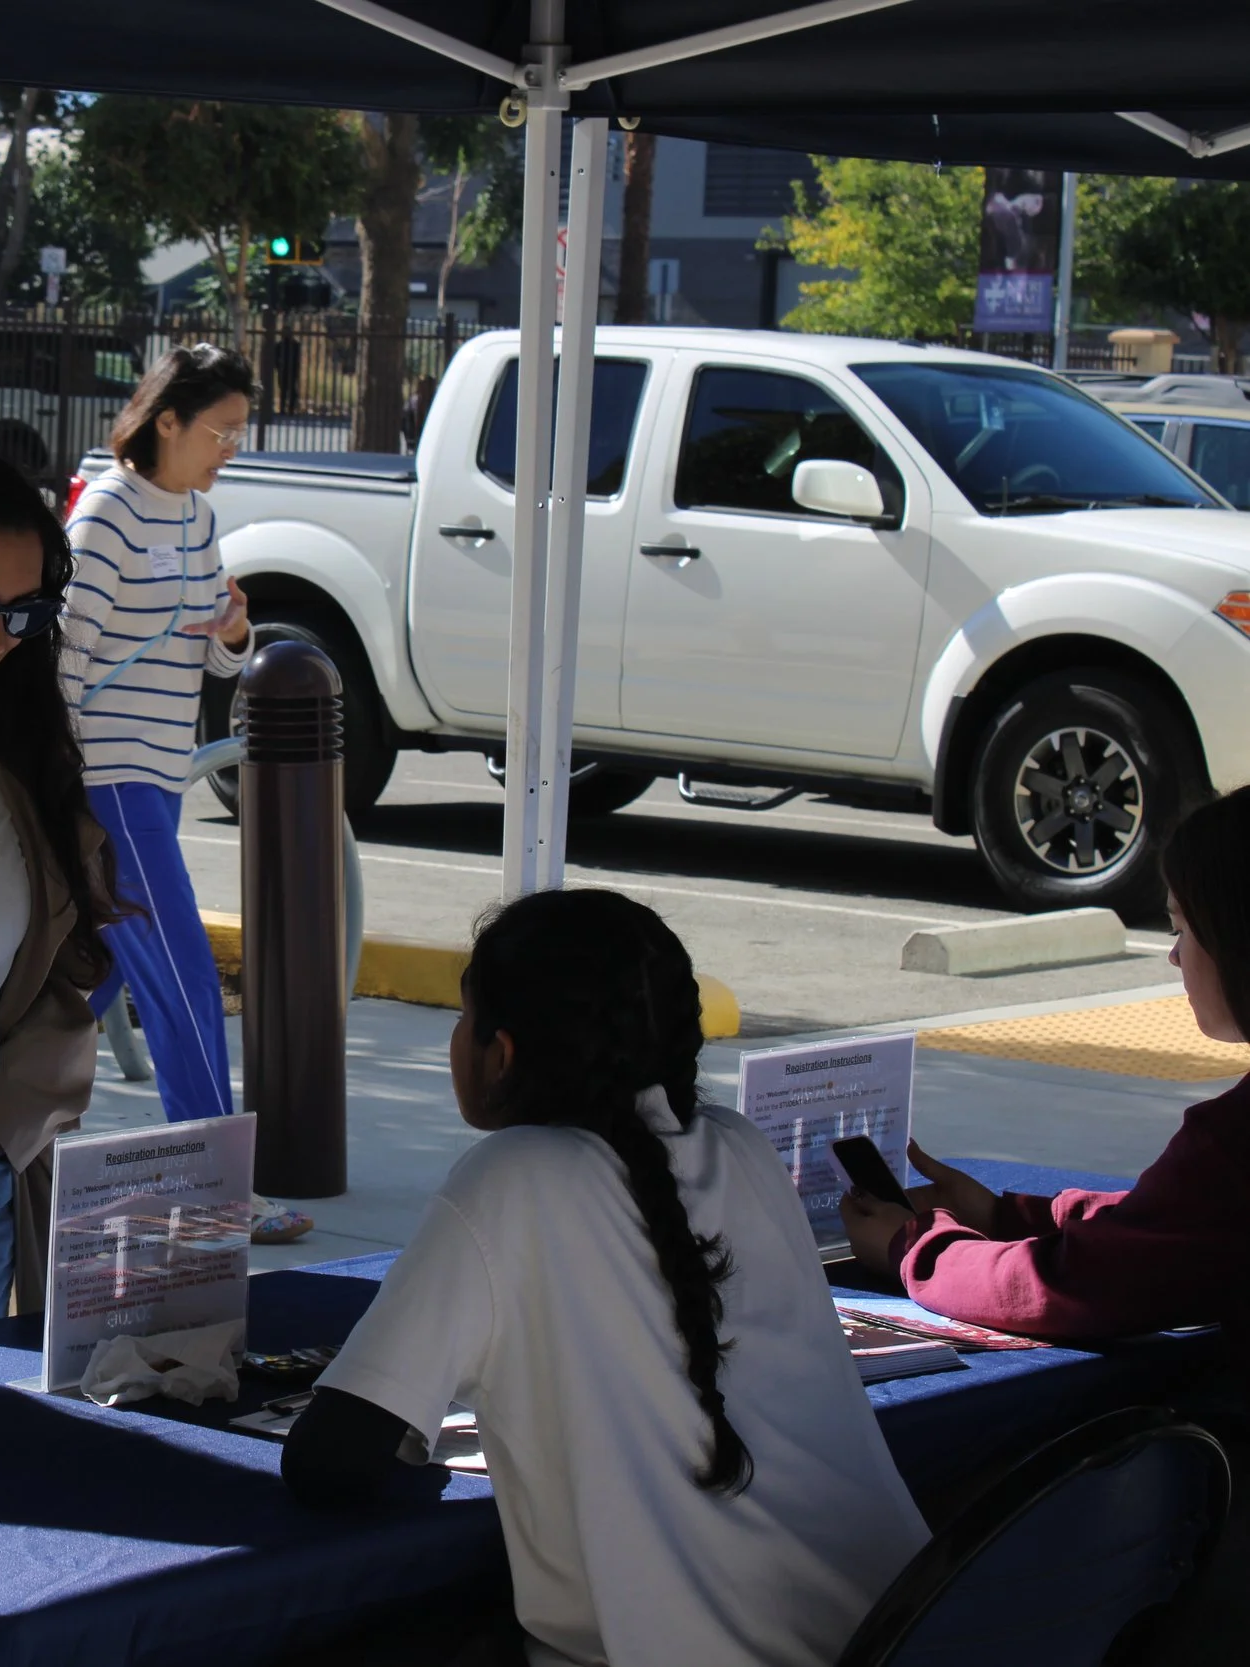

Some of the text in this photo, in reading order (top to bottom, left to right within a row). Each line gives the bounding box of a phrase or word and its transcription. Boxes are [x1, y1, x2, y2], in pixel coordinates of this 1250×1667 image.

[785, 1052, 872, 1075] Registration Instructions
[105, 1141, 206, 1167] Registration Instructions
[68, 1253, 85, 1262] make
[67, 1278, 80, 1287] FOR
